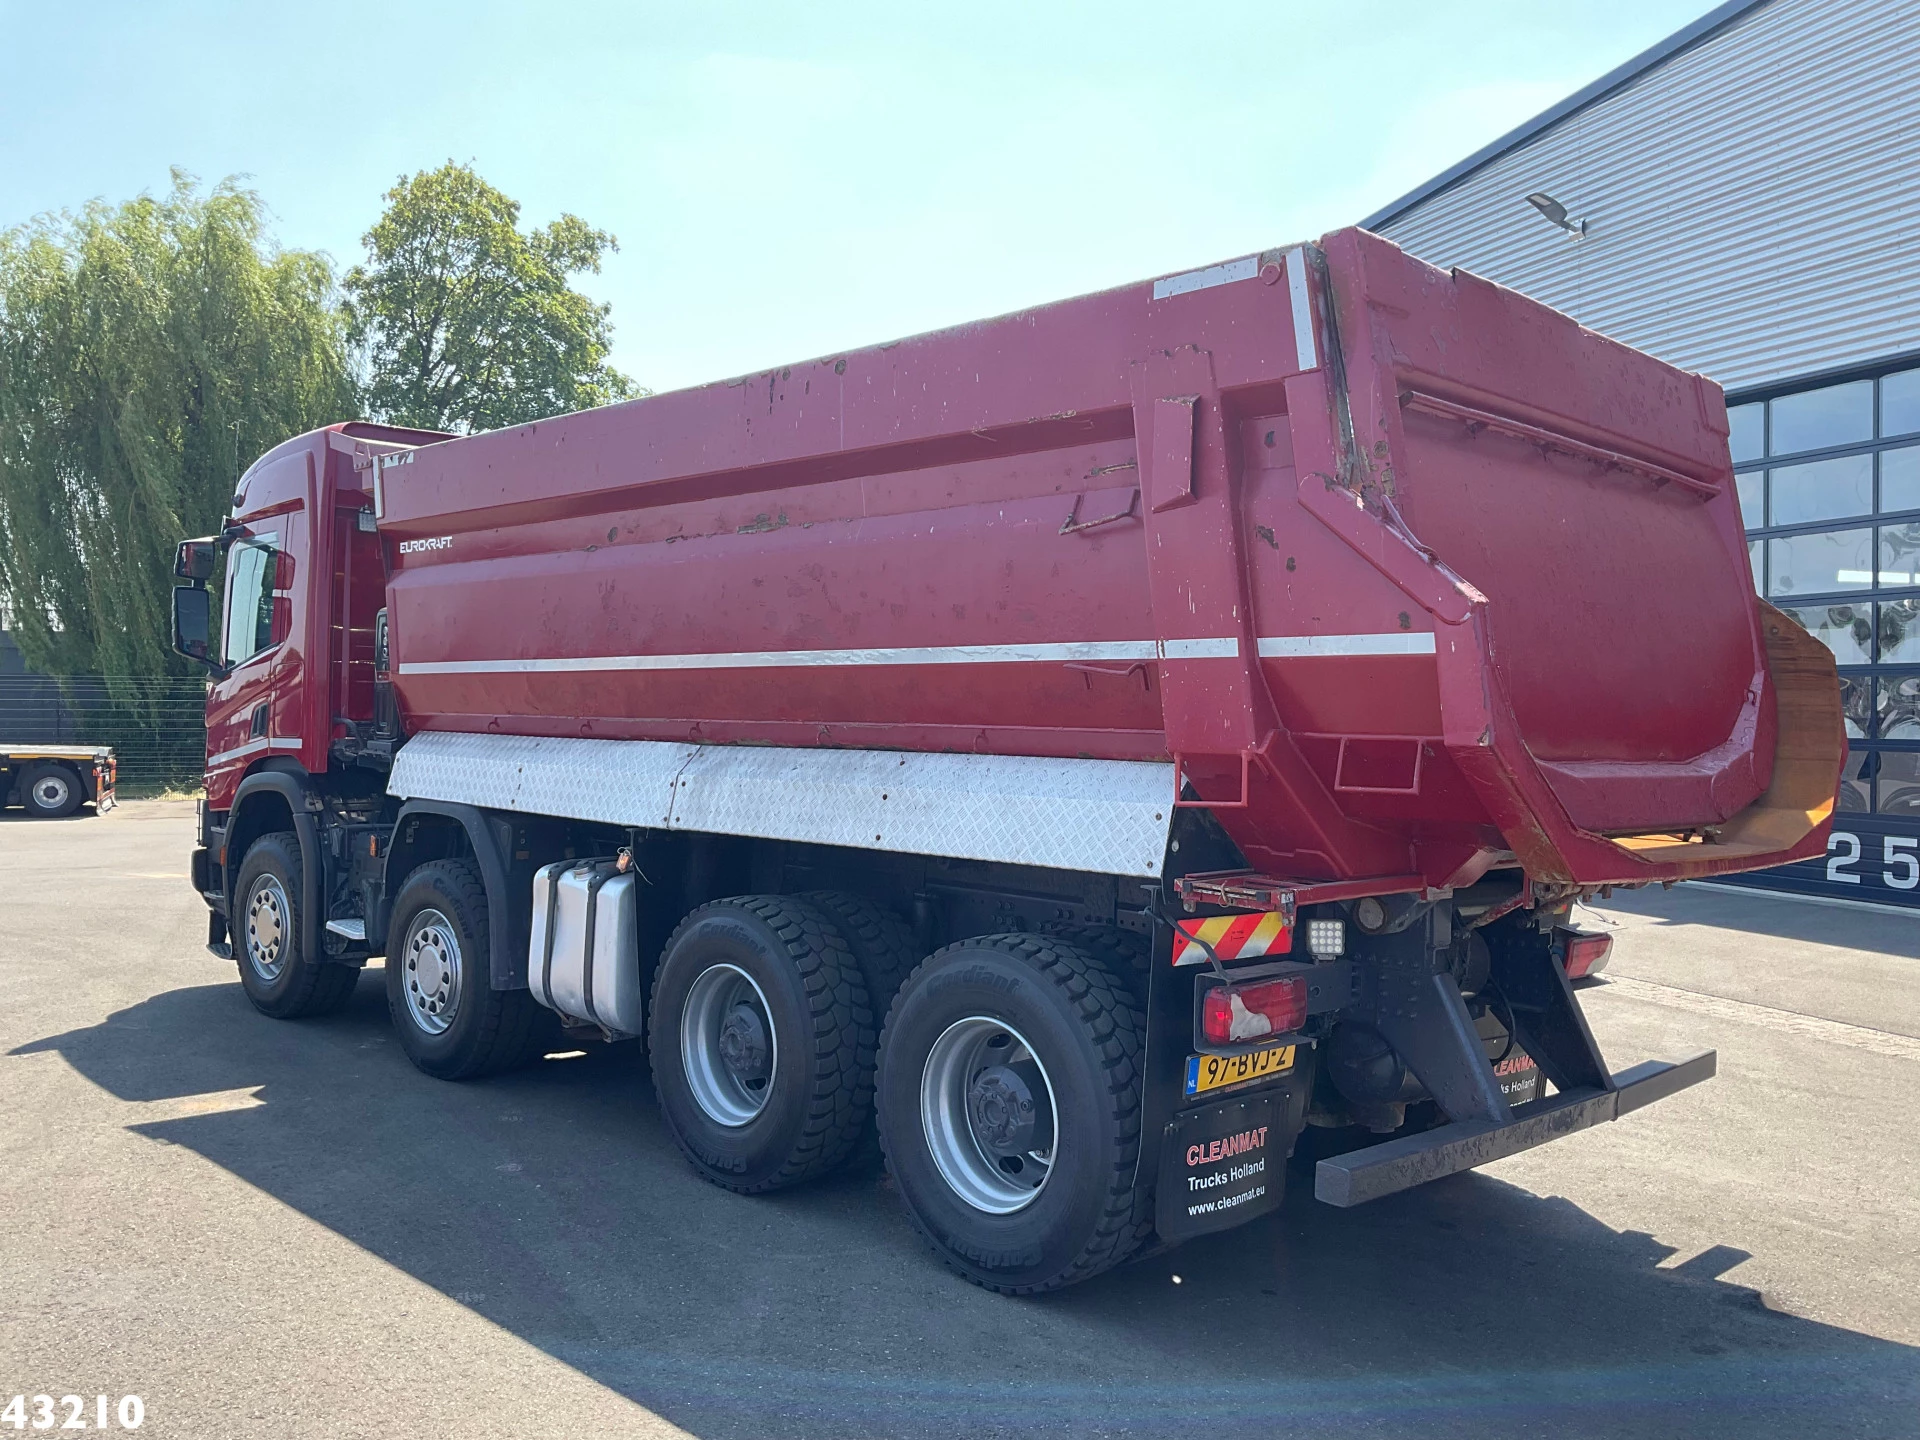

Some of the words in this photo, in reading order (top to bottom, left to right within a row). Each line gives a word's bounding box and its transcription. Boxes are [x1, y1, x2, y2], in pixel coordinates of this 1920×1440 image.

[1186, 1126, 1268, 1166] CLEANMAT
[1188, 1172, 1228, 1191] Trucks
[1230, 1157, 1265, 1181] Holland
[1188, 1184, 1265, 1216] www.cleanmat.eu
